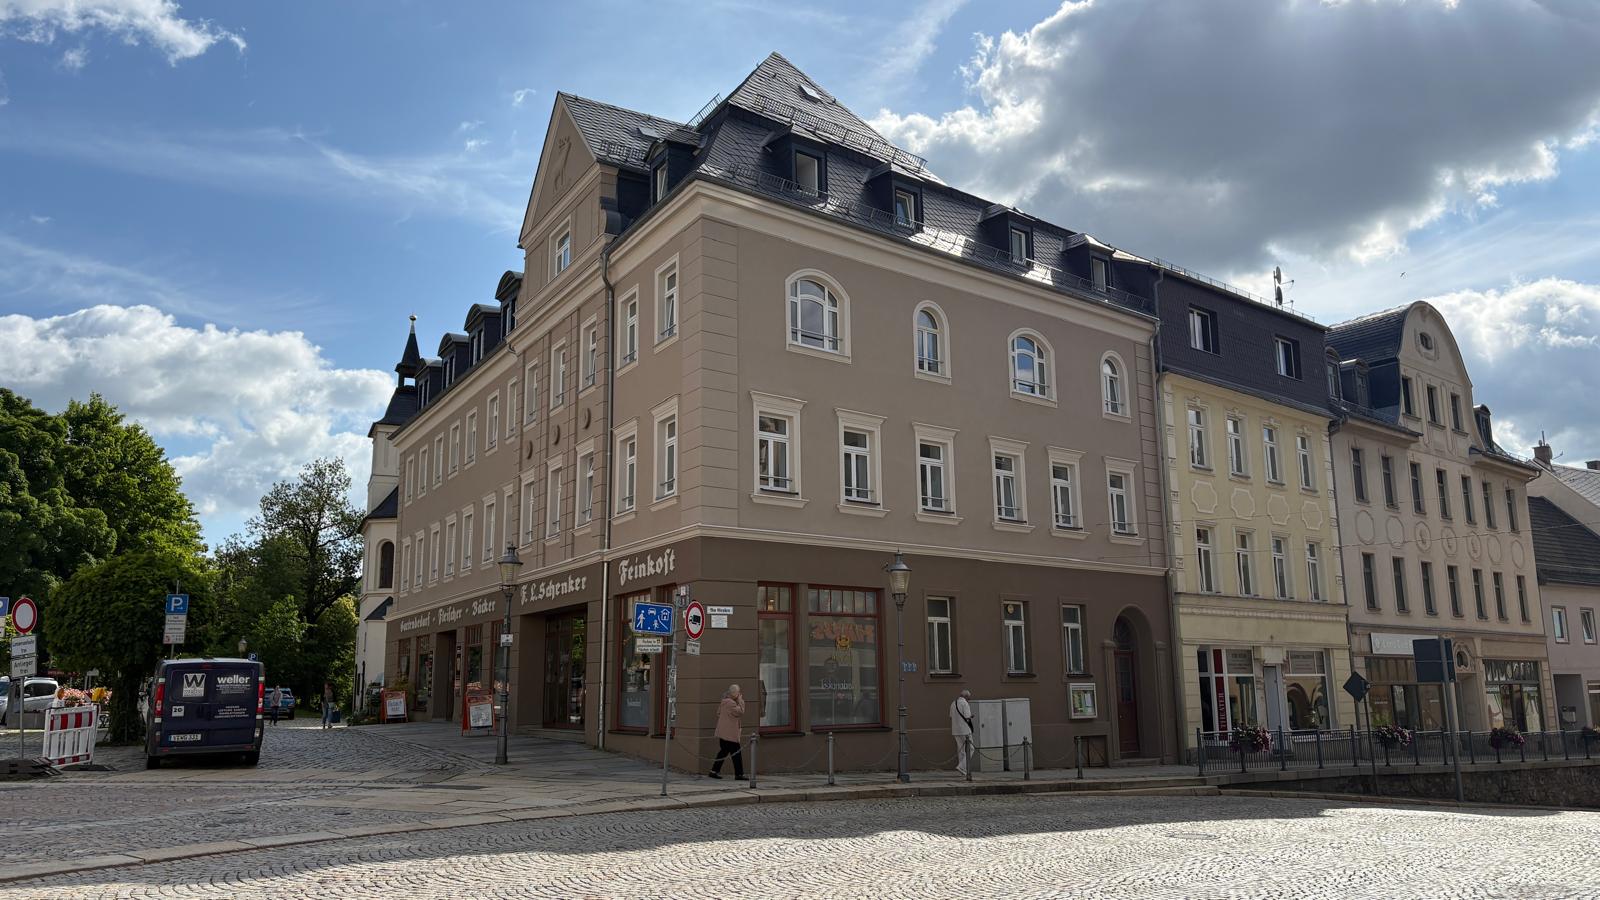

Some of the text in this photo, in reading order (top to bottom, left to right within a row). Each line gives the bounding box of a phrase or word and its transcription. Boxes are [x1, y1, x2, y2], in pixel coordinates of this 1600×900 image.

[538, 574, 587, 601] Schenker
[171, 597, 183, 611] P
[472, 598, 496, 616] Bäcker
[217, 674, 250, 684] weller
